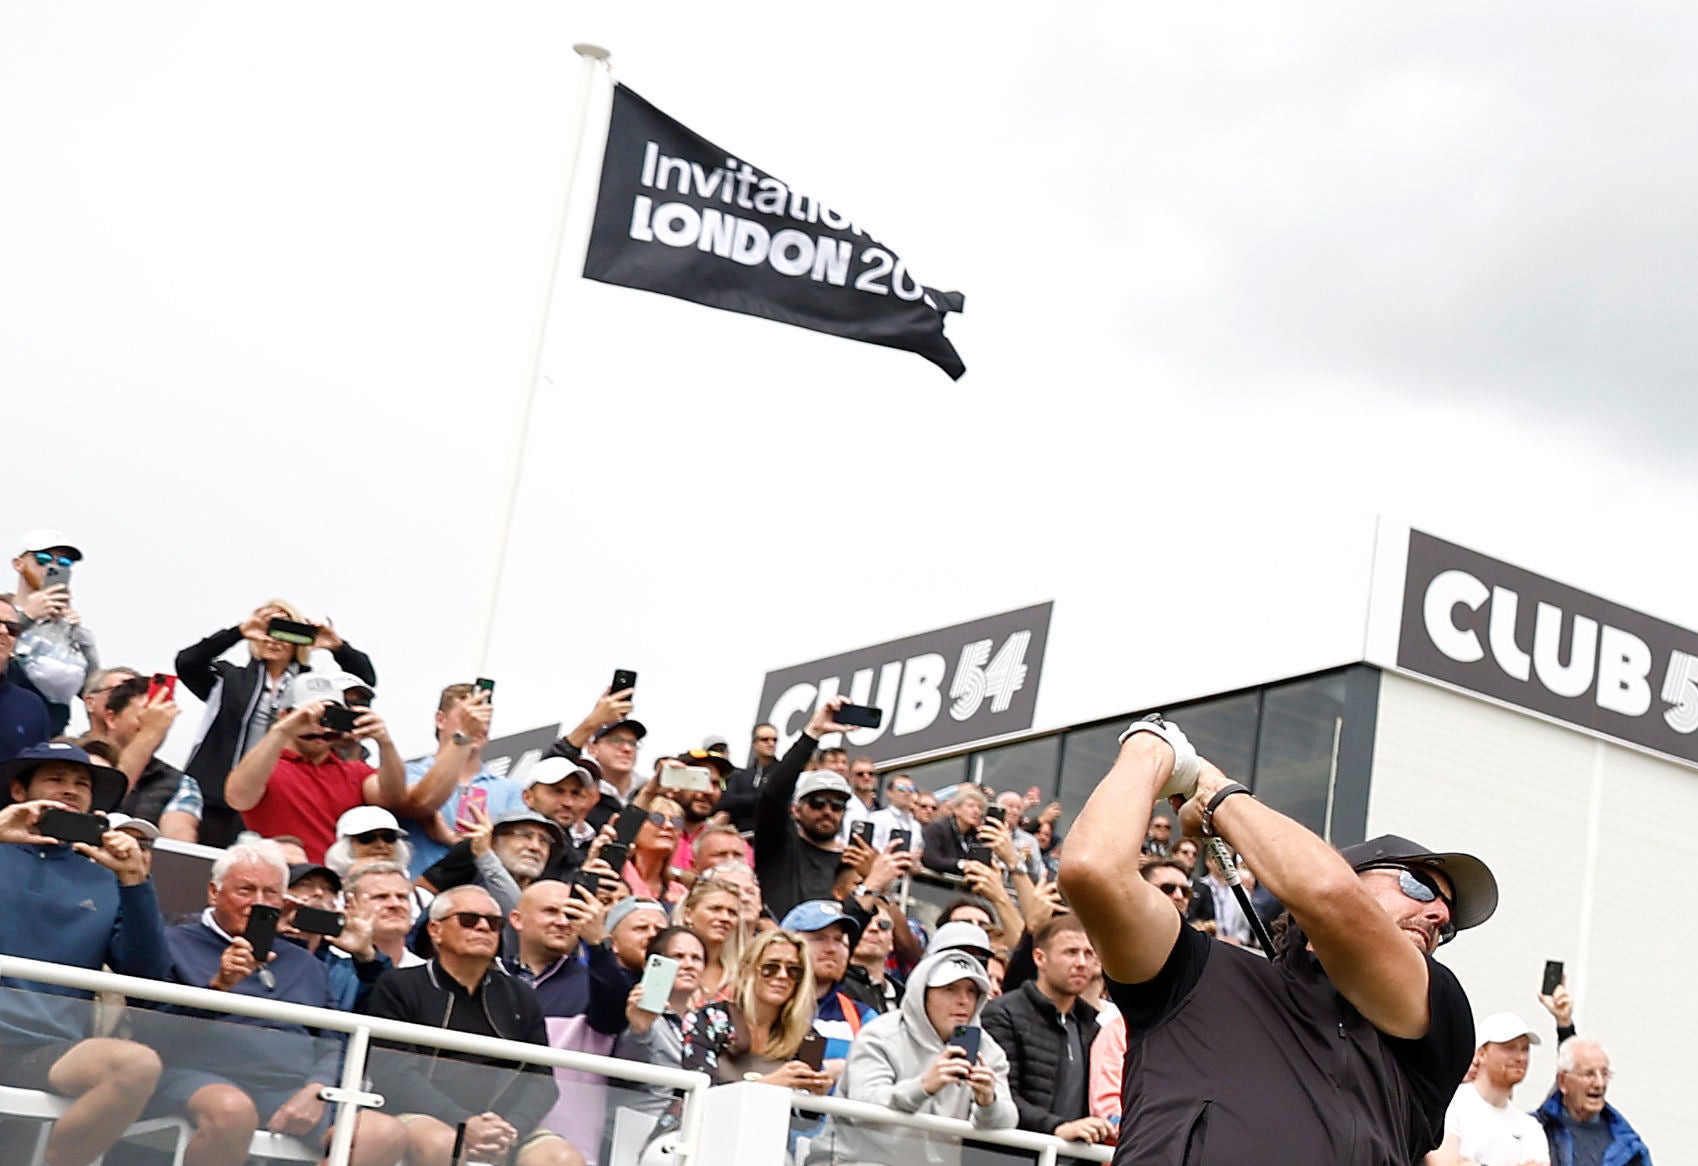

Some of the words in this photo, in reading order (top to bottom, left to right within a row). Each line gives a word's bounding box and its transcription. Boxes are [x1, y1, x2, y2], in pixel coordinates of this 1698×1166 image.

[629, 194, 853, 287] LONDON
[854, 246, 938, 310] 20
[948, 628, 1033, 722] 54
[1422, 567, 1653, 718] CLUB
